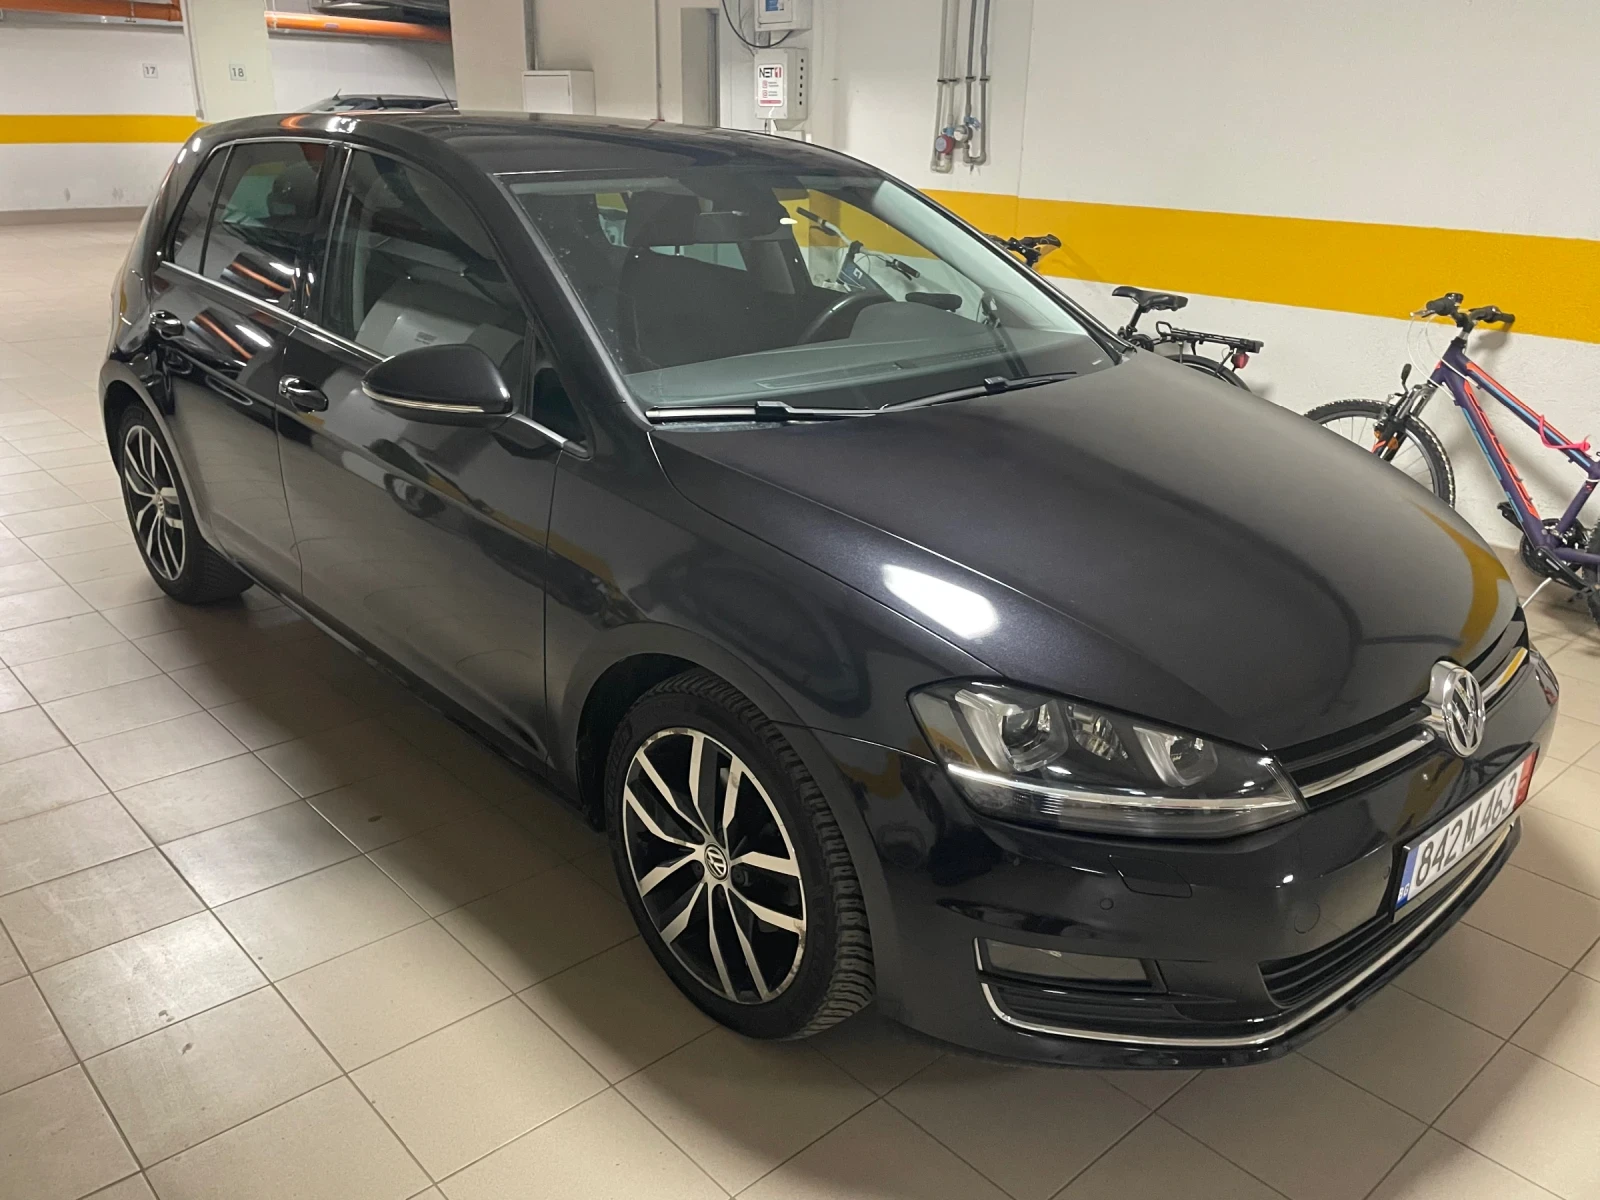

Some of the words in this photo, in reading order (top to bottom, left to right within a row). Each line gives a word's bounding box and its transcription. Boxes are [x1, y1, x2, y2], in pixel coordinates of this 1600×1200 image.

[144, 66, 156, 75] 17
[231, 67, 245, 78] 18
[1397, 882, 1411, 901] BG
